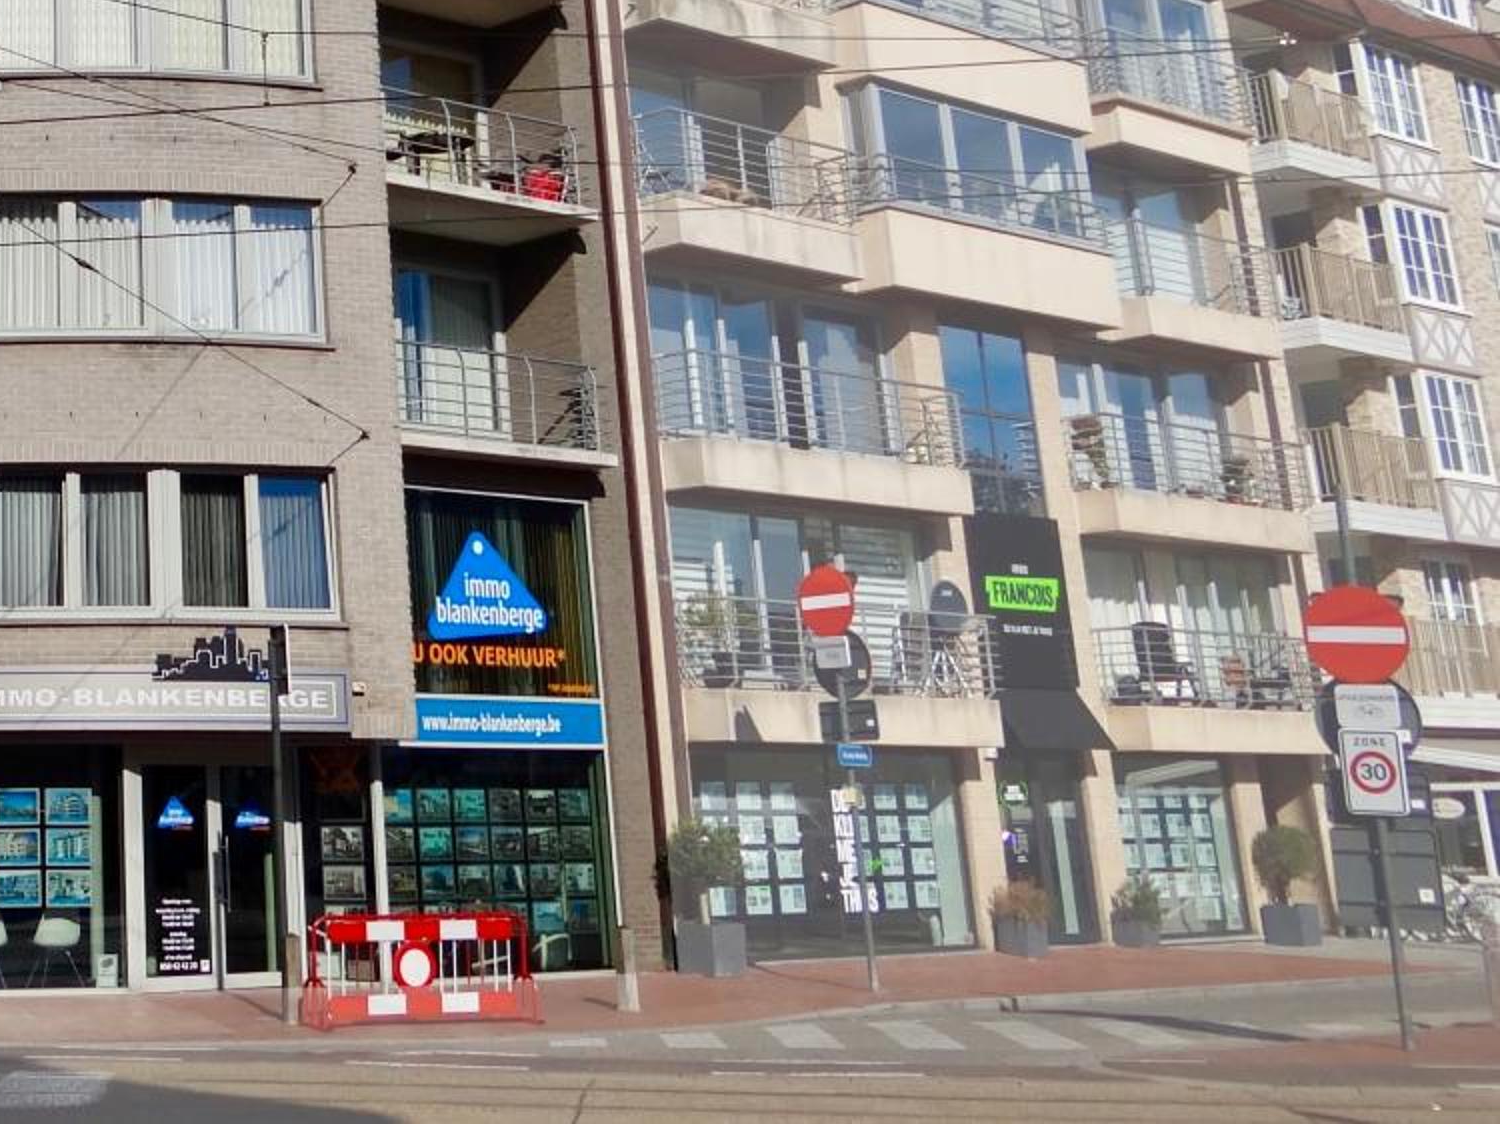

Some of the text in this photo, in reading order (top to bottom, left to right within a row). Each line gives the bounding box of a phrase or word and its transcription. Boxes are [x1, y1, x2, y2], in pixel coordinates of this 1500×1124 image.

[463, 572, 511, 600] immo
[436, 596, 545, 633] blankenberge
[429, 644, 468, 665] OOK
[422, 713, 561, 737] www.immo-blankenberge.be
[1353, 737, 1387, 747] ZONE
[1360, 763, 1387, 781] 30
